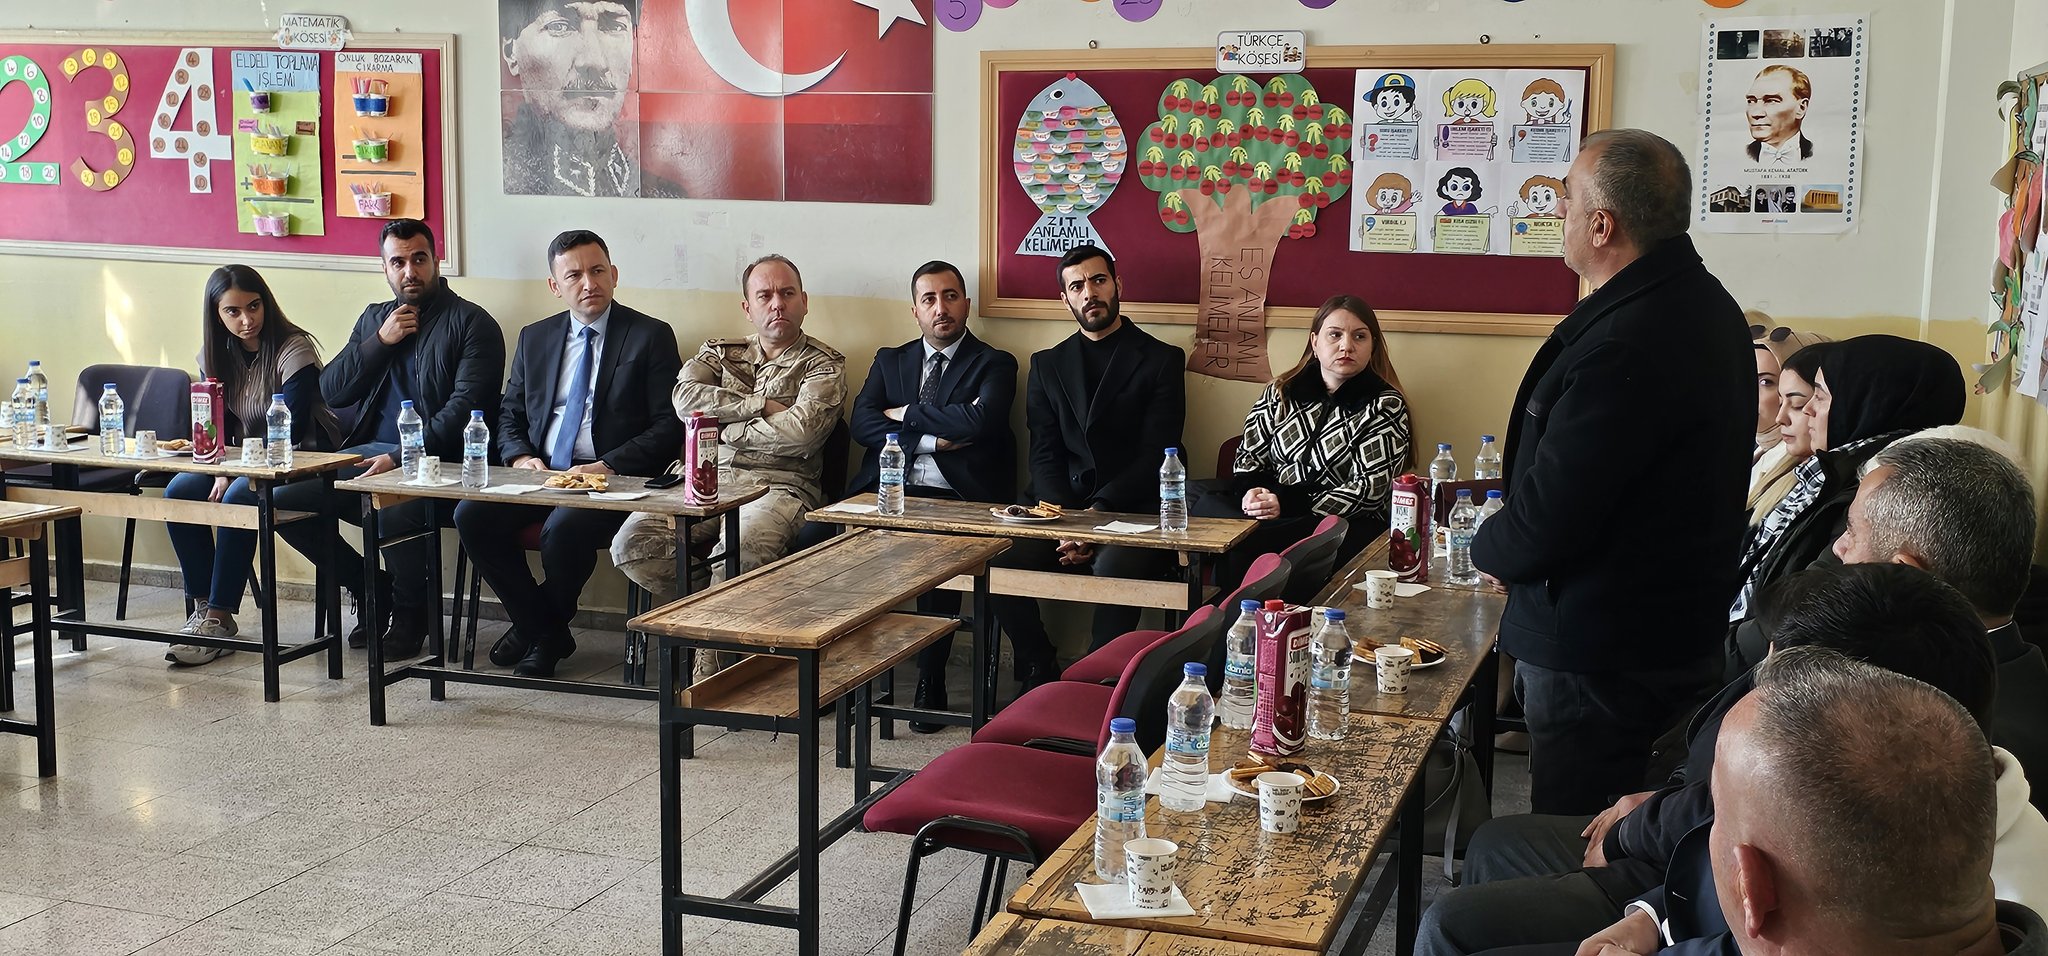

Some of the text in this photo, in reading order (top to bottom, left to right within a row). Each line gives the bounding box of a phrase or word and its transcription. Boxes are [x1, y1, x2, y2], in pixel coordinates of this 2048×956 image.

[282, 16, 341, 28] MATEMATİK
[293, 31, 327, 43] KÖŞESİ
[1238, 32, 1284, 49] TÜRKÇE
[273, 54, 319, 72] TOPLAMA
[338, 53, 413, 64] ONLUK BOZARAK
[1238, 50, 1281, 67] KÖŞESİ
[356, 64, 394, 72] ÇIKARMA
[258, 71, 295, 87] İŞLEMİ
[1047, 216, 1077, 227] ZIT
[1031, 226, 1089, 239] ANLAMLI
[1204, 257, 1235, 369] KELİMELER
[1235, 247, 1264, 379] EŞ ANLAMLI
[1226, 663, 1252, 675] damla
